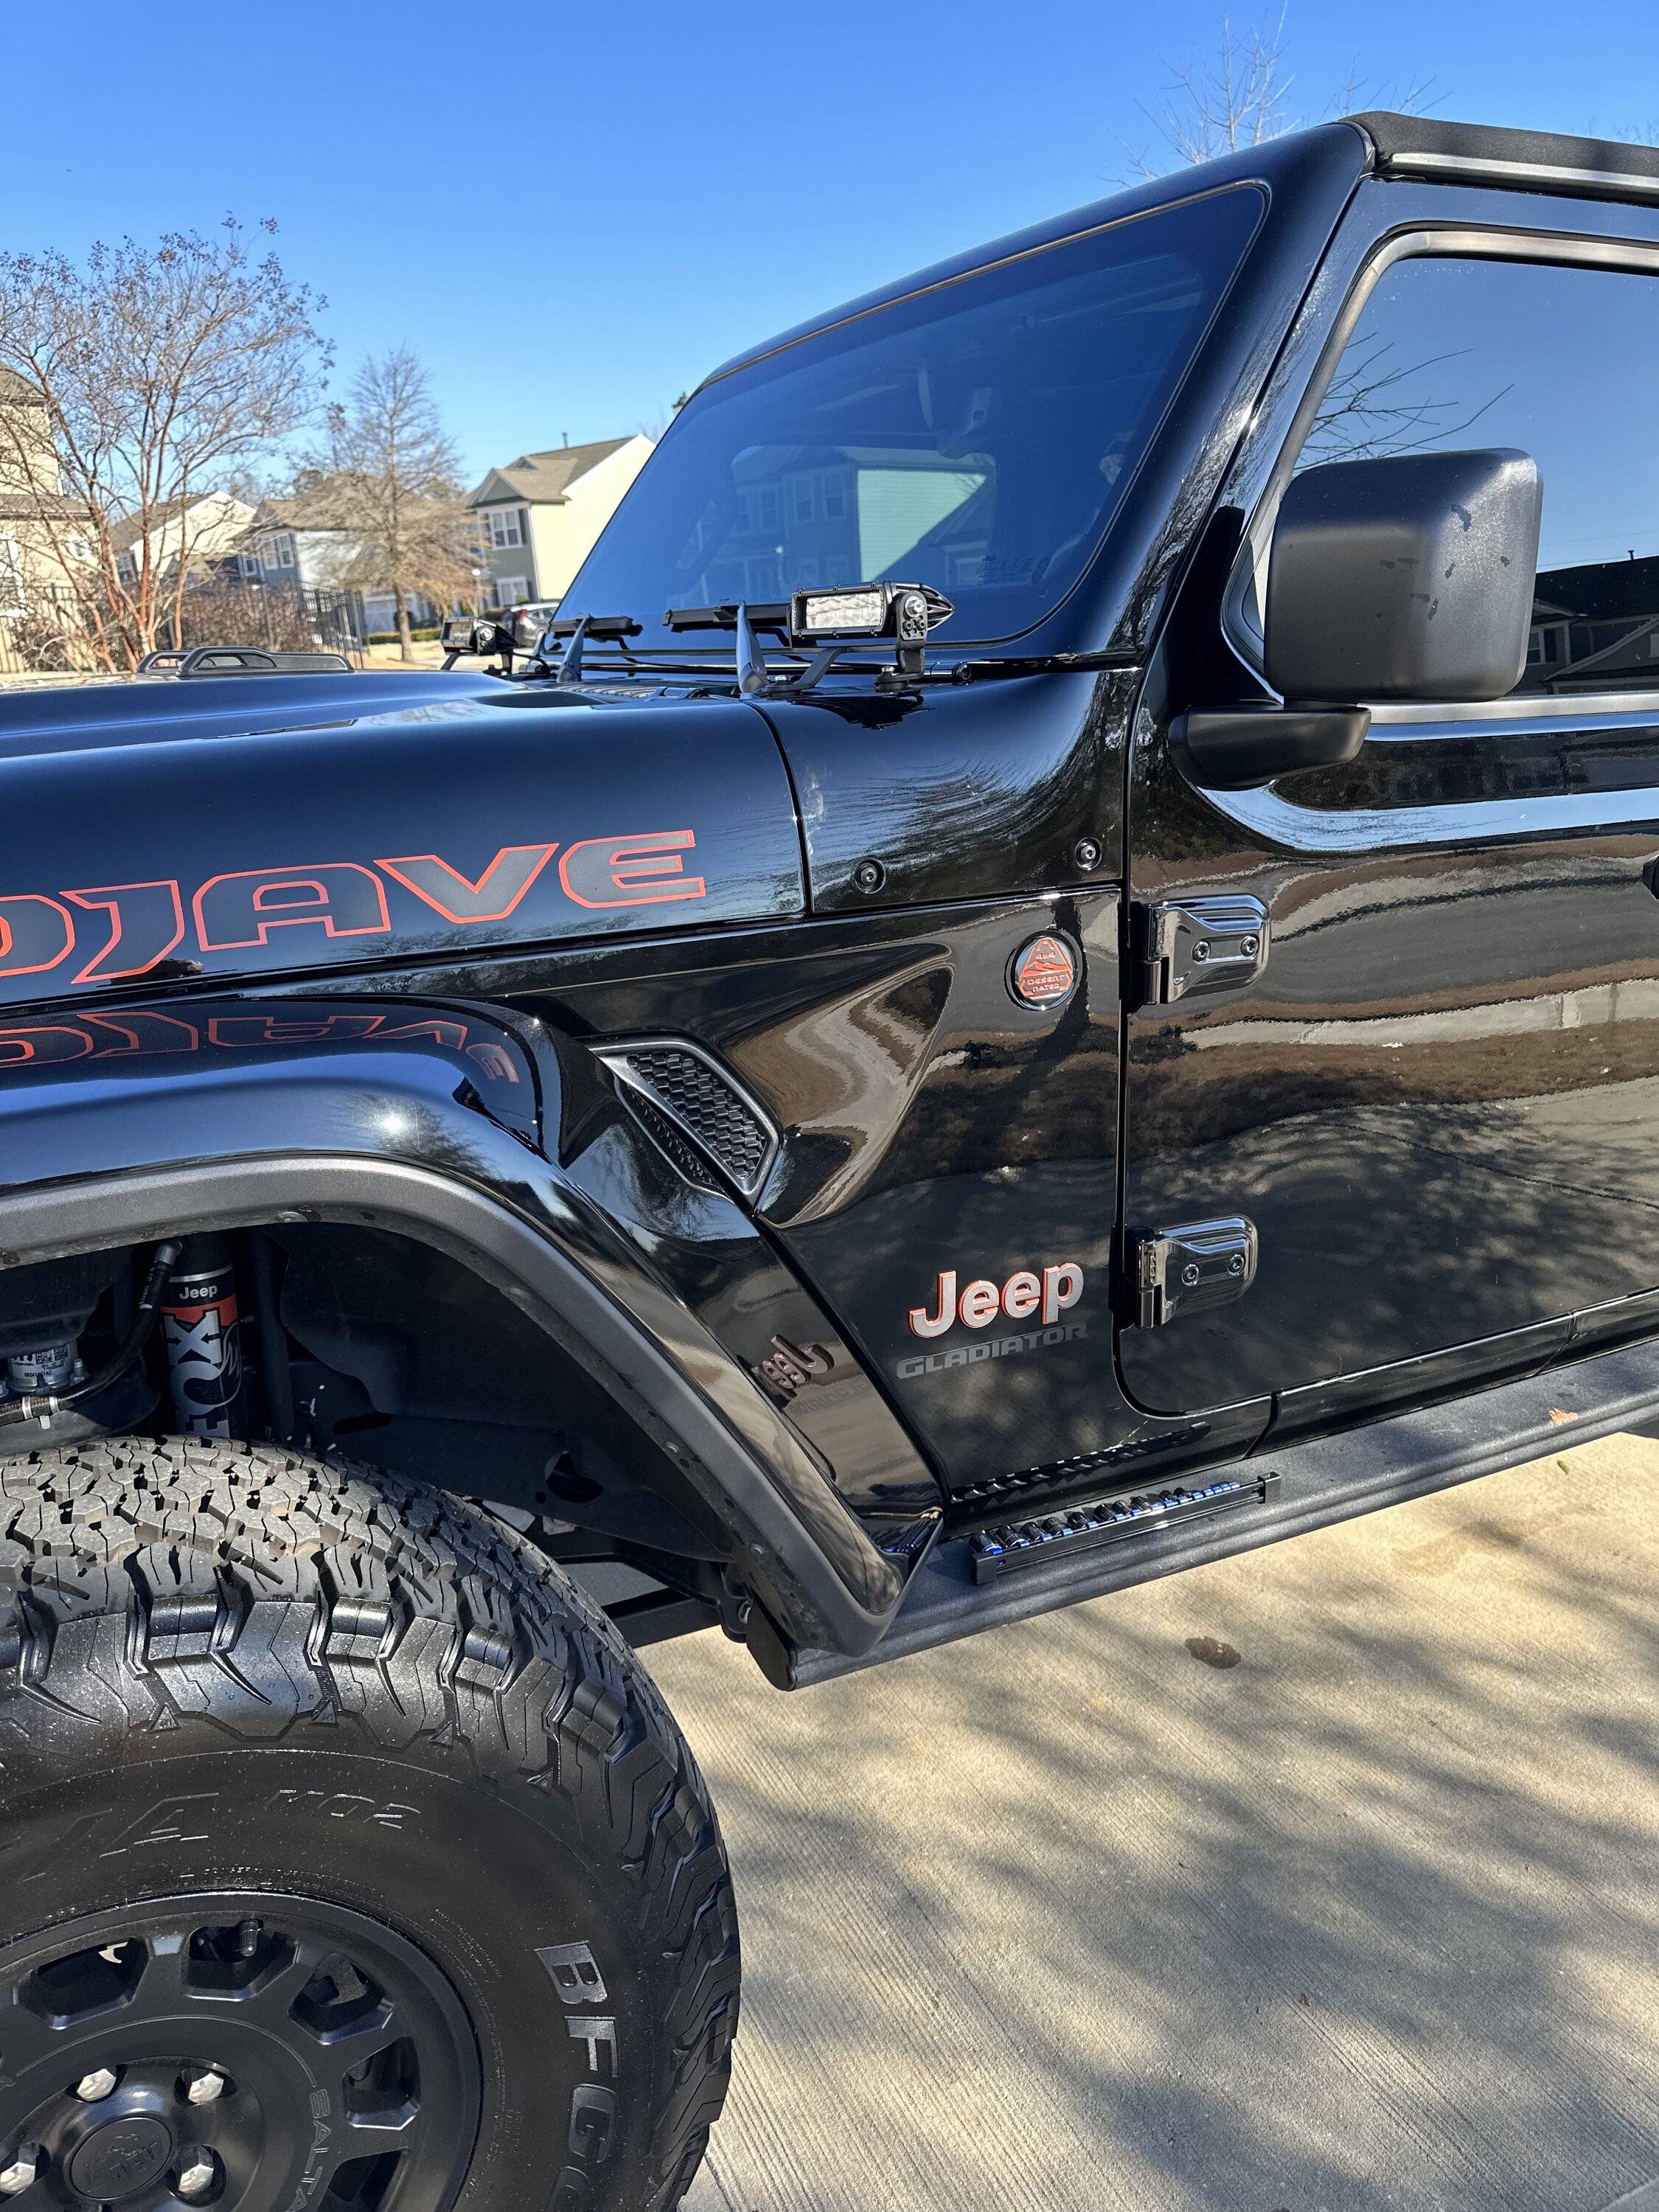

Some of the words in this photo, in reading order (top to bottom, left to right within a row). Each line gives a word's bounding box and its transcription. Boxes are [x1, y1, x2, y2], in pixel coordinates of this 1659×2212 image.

[1027, 974, 1065, 986] DESERT
[179, 1284, 218, 1300] Jeep
[909, 1262, 1084, 1338] Jeep
[164, 1308, 231, 1438] FOX
[896, 1321, 1089, 1379] GLADIATOR
